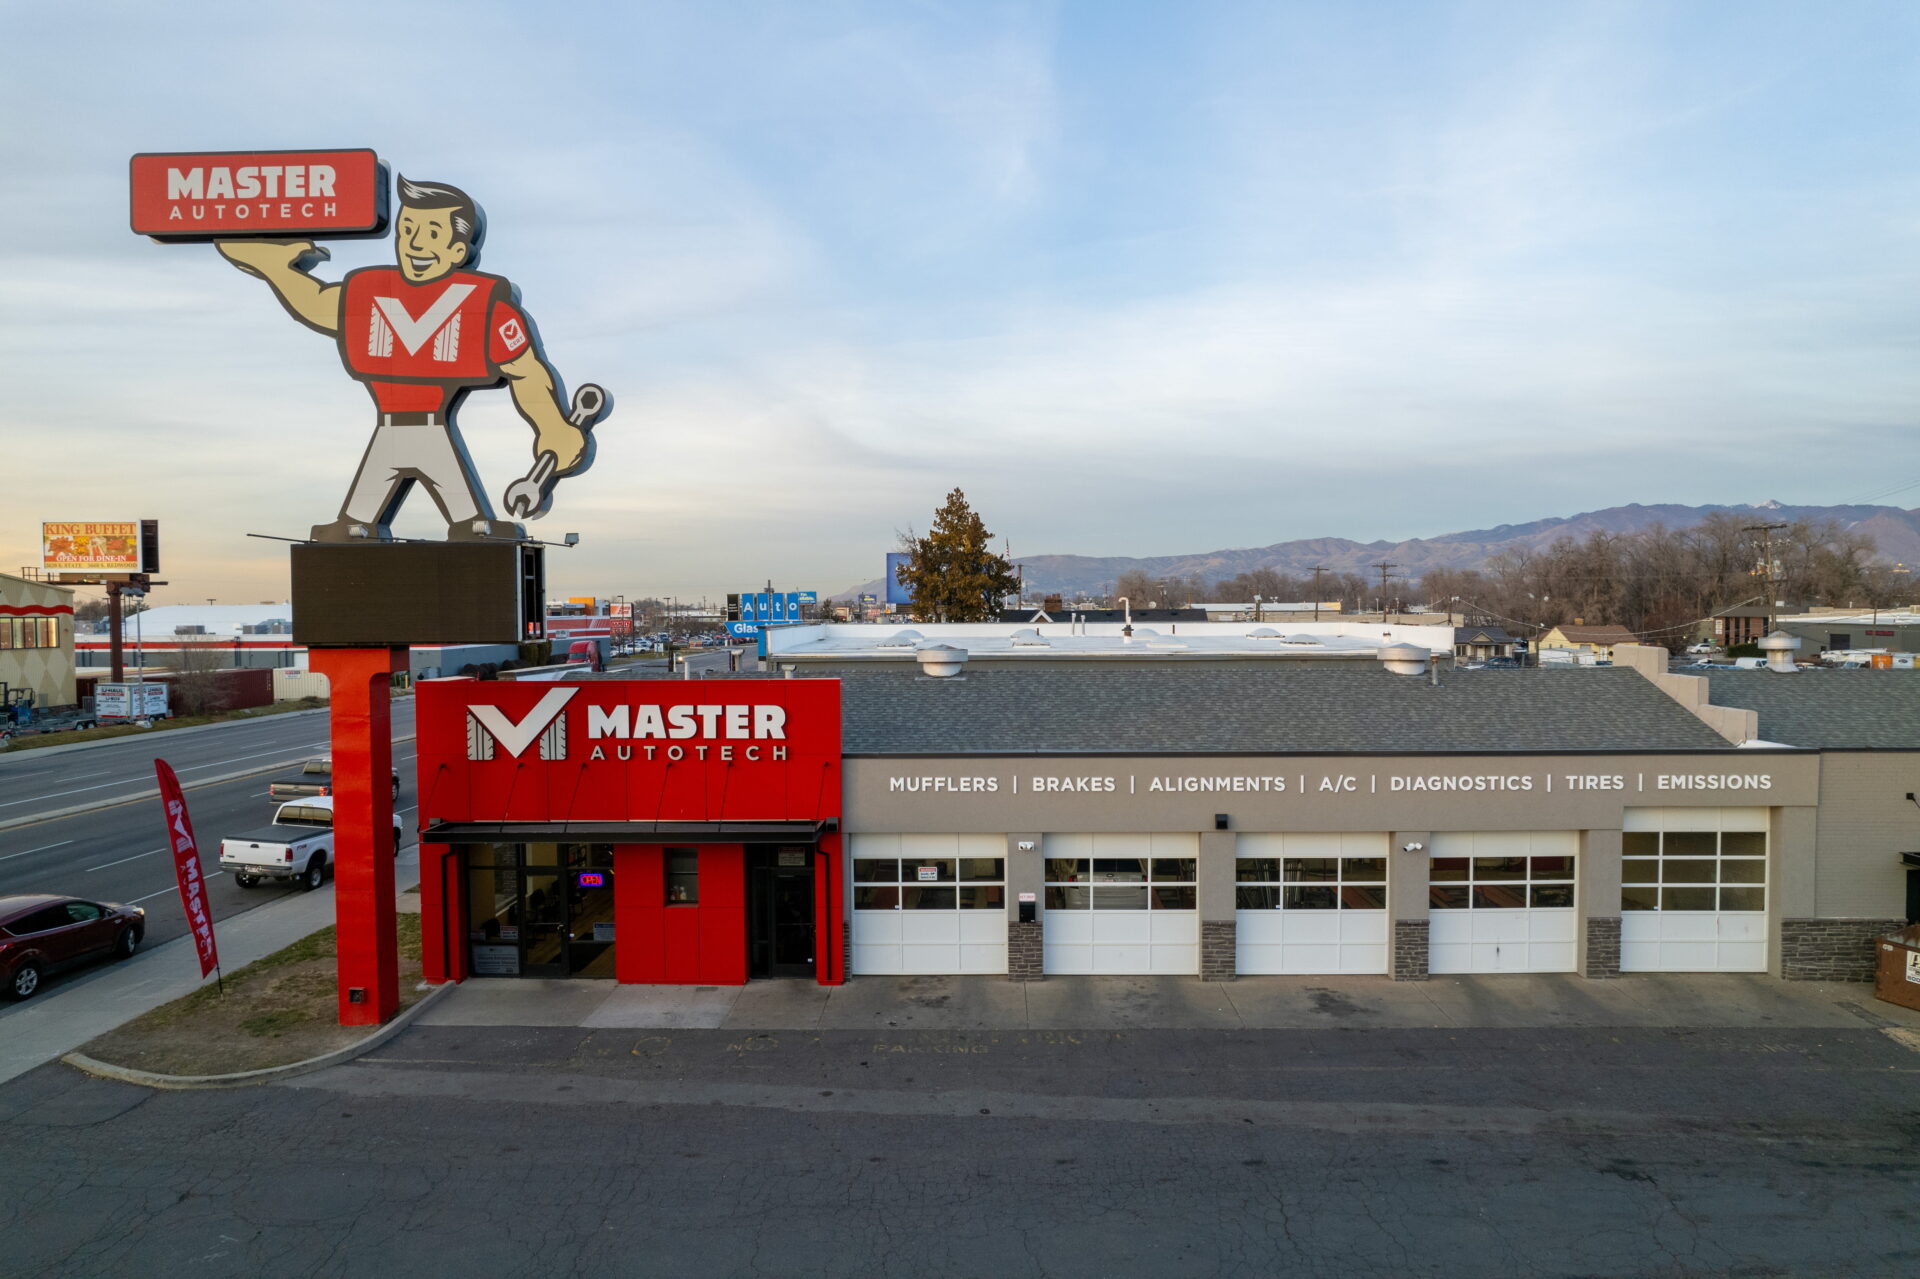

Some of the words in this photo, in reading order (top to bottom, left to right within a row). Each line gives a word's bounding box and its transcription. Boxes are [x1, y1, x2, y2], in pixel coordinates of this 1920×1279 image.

[167, 164, 337, 200] MASTER
[169, 202, 337, 220] AUTOTECH
[45, 523, 80, 535] KING
[85, 523, 137, 535] BUFFET
[743, 602, 798, 613] Auto
[733, 622, 760, 634] Glas
[587, 704, 787, 740] MASTER
[590, 745, 787, 761] AUTOTECH
[889, 776, 999, 792] MUFFLERS
[1032, 776, 1116, 792] BRAKES
[1149, 775, 1286, 792] ALIGNMENTS
[1318, 775, 1357, 793] A/C
[1390, 775, 1533, 791] DIAGNOSTICS
[1565, 774, 1625, 790] TIRES
[1657, 774, 1772, 790] EMISSIONS
[582, 875, 601, 885] OPEN
